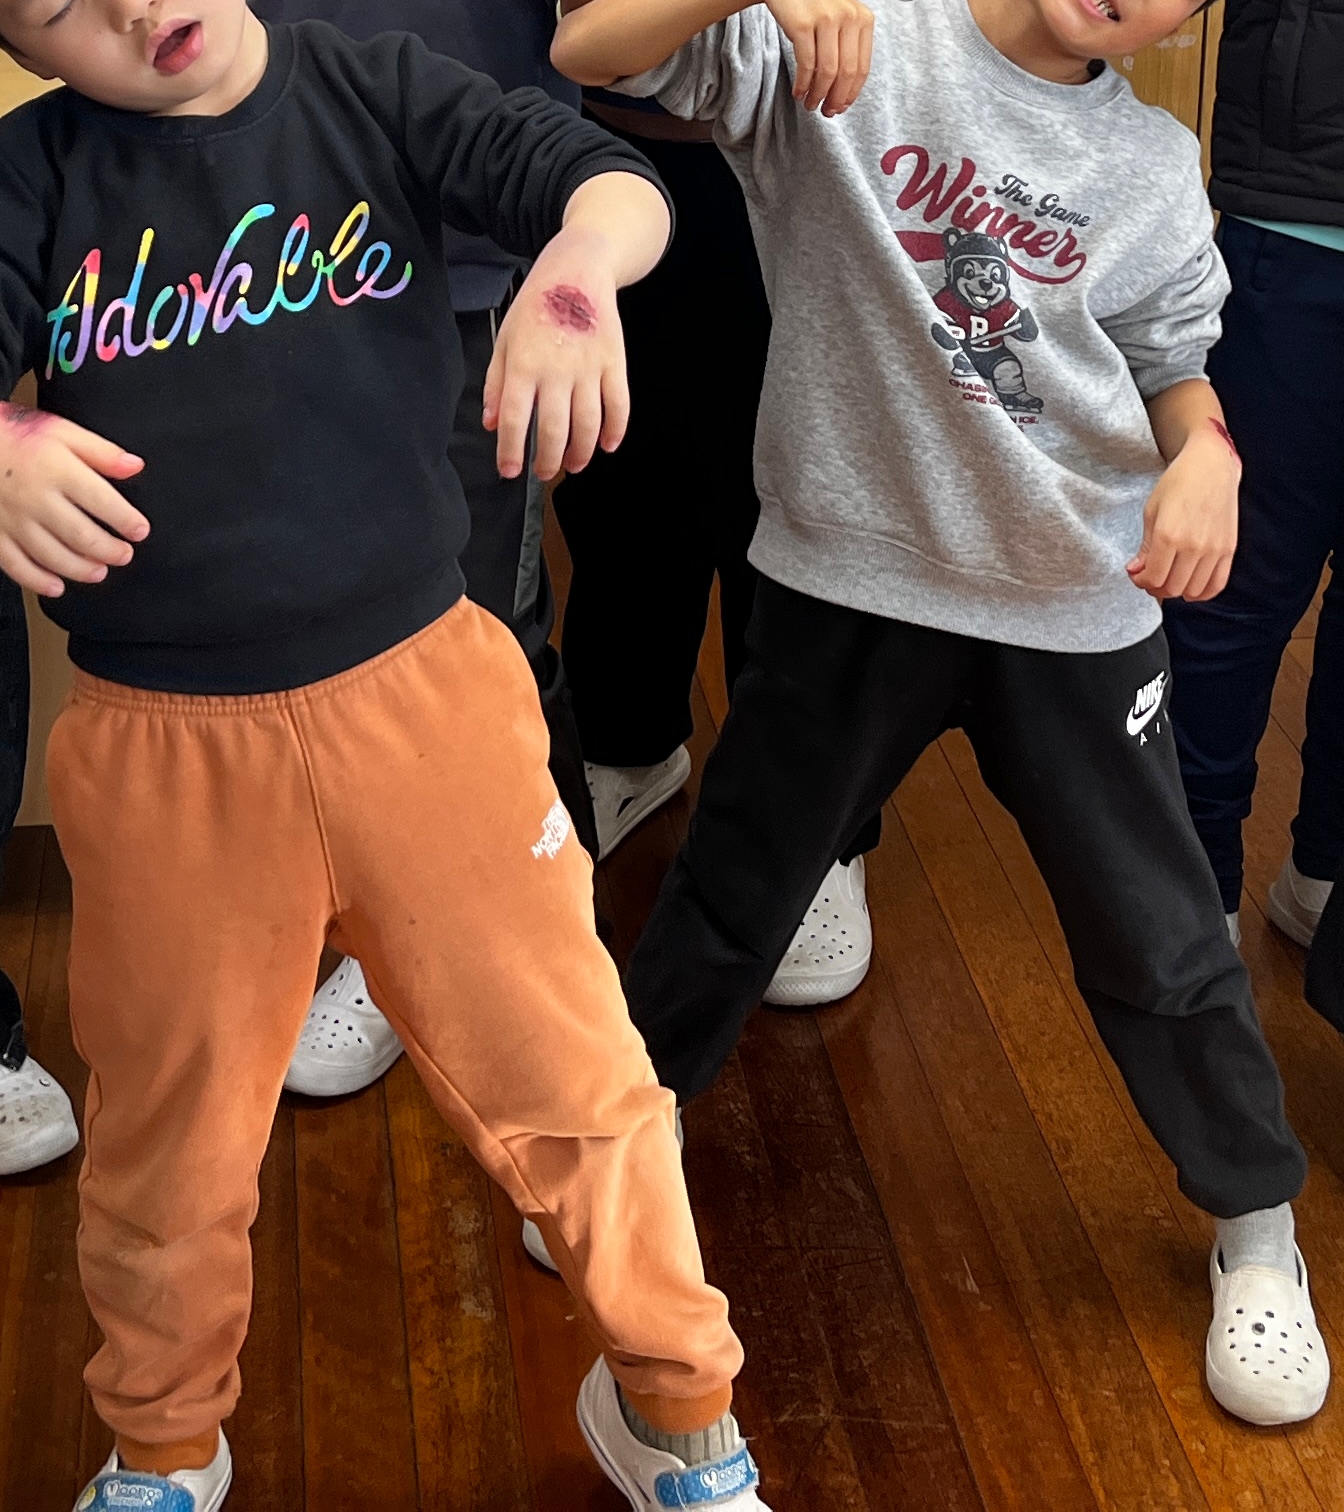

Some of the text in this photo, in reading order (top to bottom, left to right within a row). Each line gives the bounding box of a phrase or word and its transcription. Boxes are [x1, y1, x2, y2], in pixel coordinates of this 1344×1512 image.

[880, 144, 1087, 285] Winner
[994, 174, 1091, 228] The Game
[44, 200, 413, 381] Adorable
